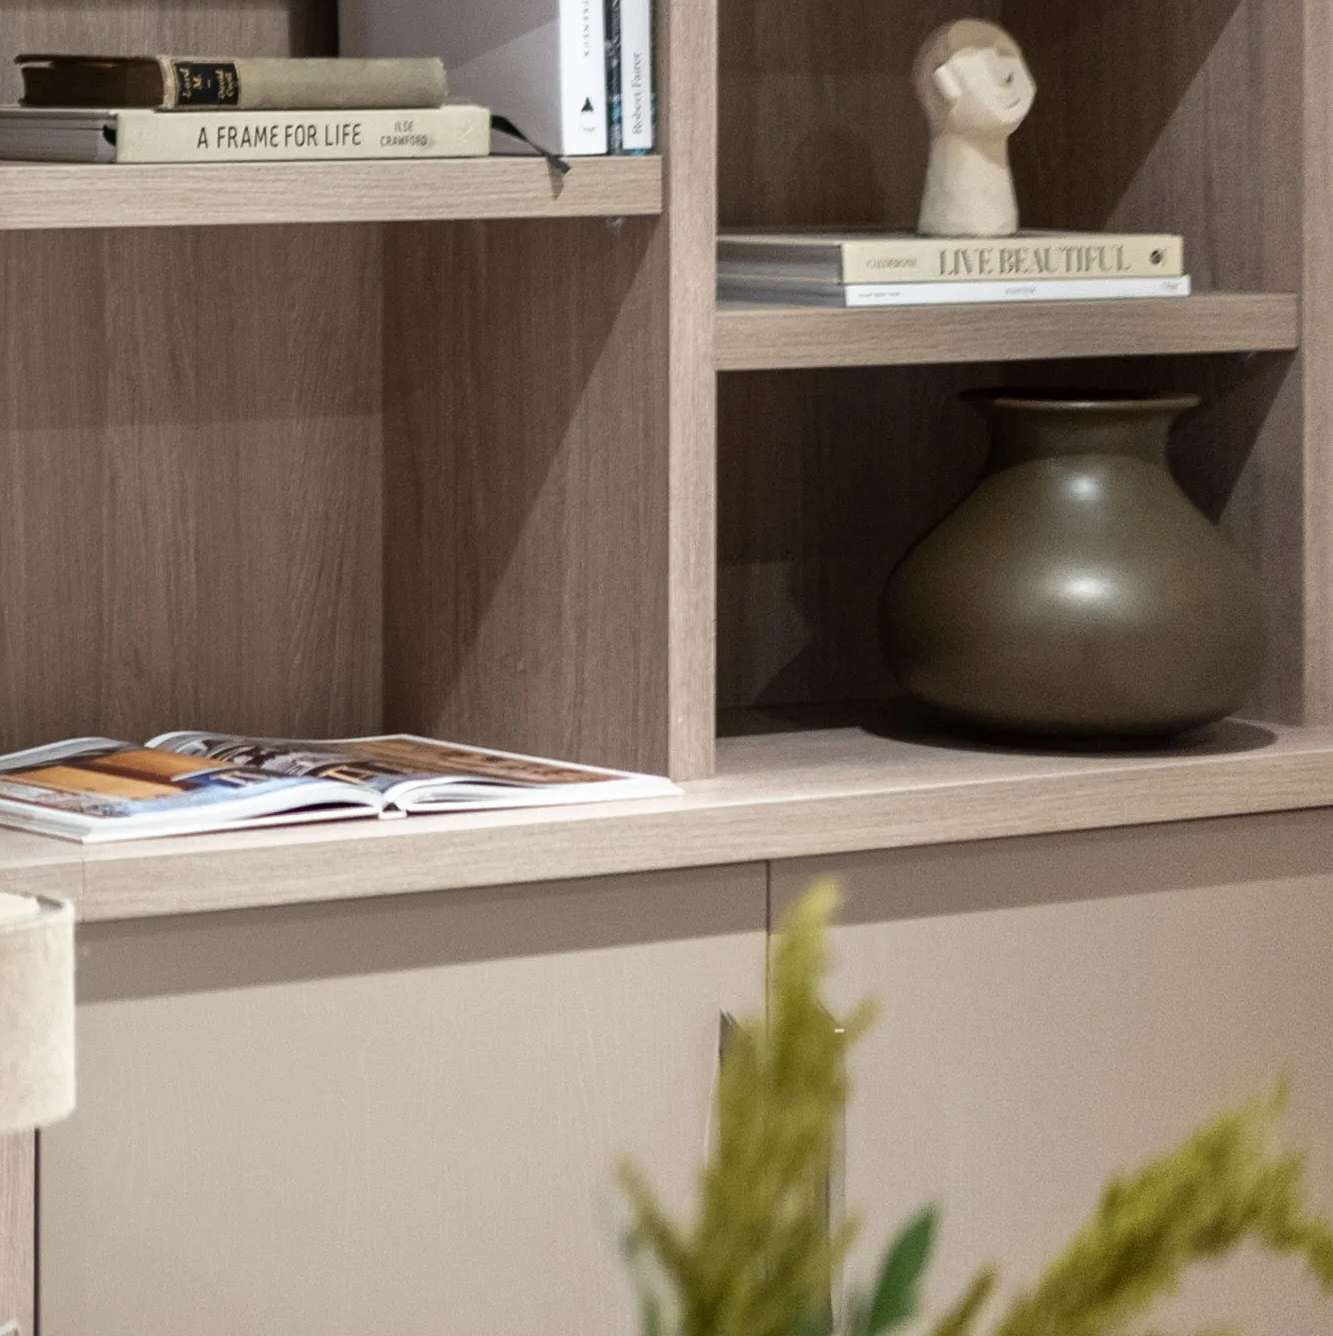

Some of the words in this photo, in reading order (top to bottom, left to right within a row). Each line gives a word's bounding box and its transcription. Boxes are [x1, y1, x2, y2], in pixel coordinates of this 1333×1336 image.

[393, 120, 414, 133] ILSE
[631, 91, 643, 136] Robert
[196, 126, 209, 149] A
[216, 124, 280, 148] FRAME
[284, 123, 319, 147] FOR
[324, 122, 363, 146] LIFE
[379, 133, 429, 147] CRAWFORD
[938, 247, 994, 277] LIVE
[998, 244, 1133, 275] BEAUTIFUL
